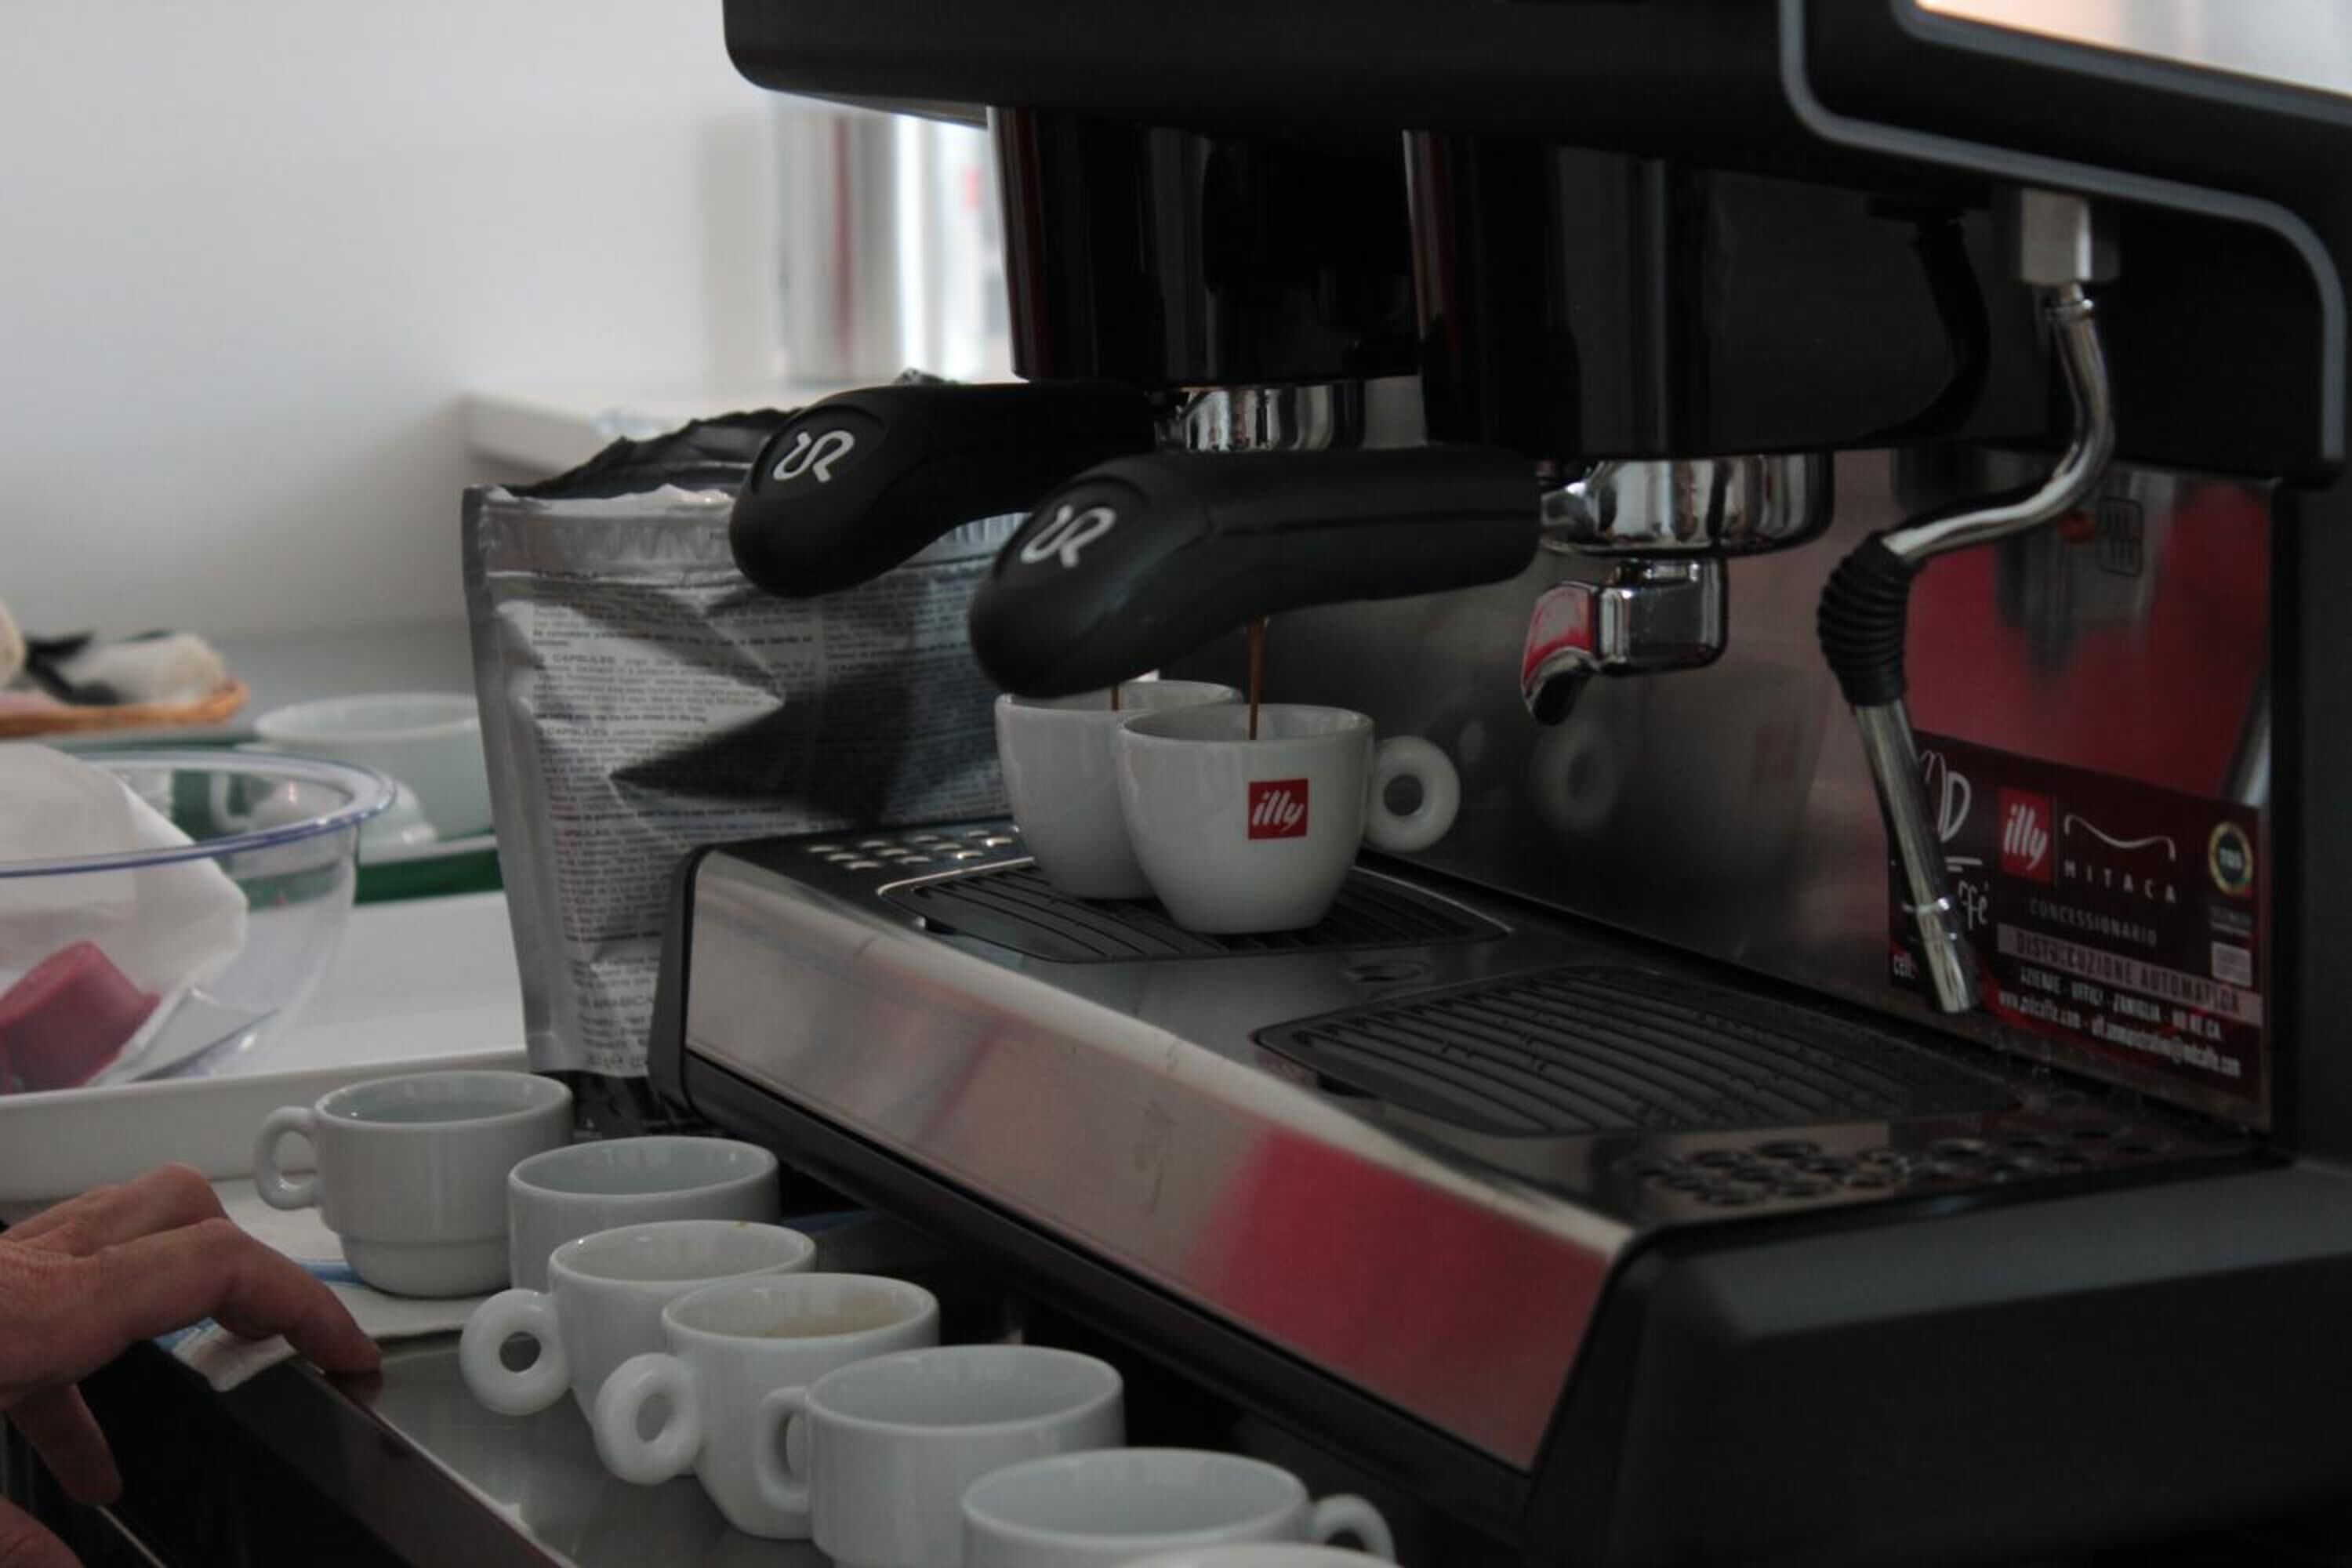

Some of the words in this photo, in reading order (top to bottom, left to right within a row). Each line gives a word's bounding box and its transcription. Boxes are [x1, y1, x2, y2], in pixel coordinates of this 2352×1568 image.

[1252, 790, 1305, 832] illy
[2004, 803, 2048, 871] illy
[2064, 861, 2176, 903] MITACA
[2030, 898, 2157, 946] CONCESSIONARIO
